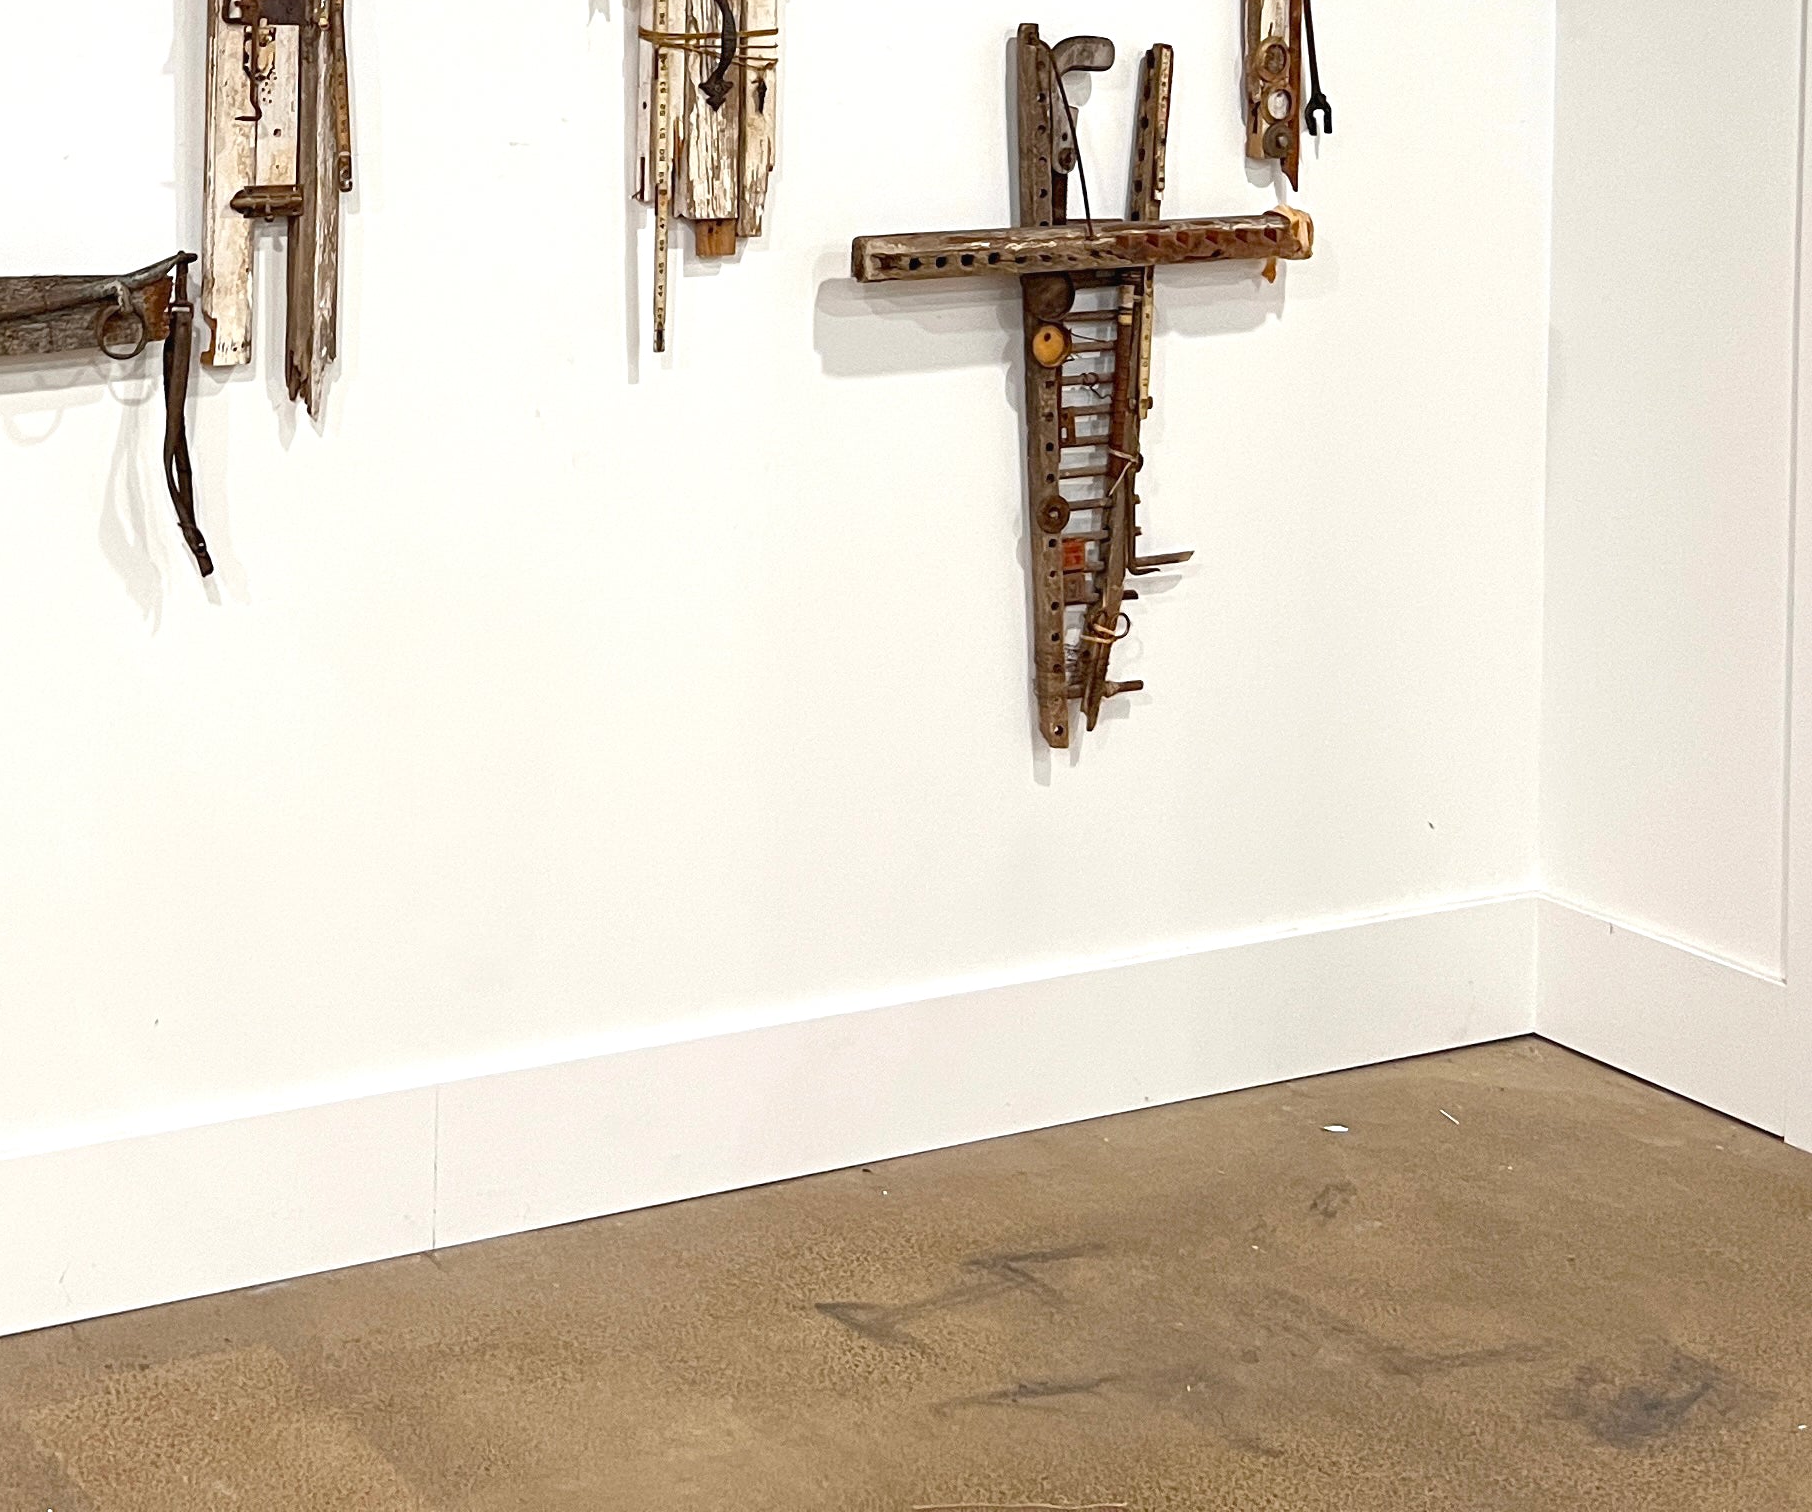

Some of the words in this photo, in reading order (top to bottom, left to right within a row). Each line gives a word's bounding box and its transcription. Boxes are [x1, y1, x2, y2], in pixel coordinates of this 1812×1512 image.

[659, 81, 666, 94] 53
[659, 103, 666, 117] 52
[659, 127, 666, 139] 51
[659, 148, 665, 162] 50
[659, 217, 665, 230] 47
[658, 284, 664, 297] 44
